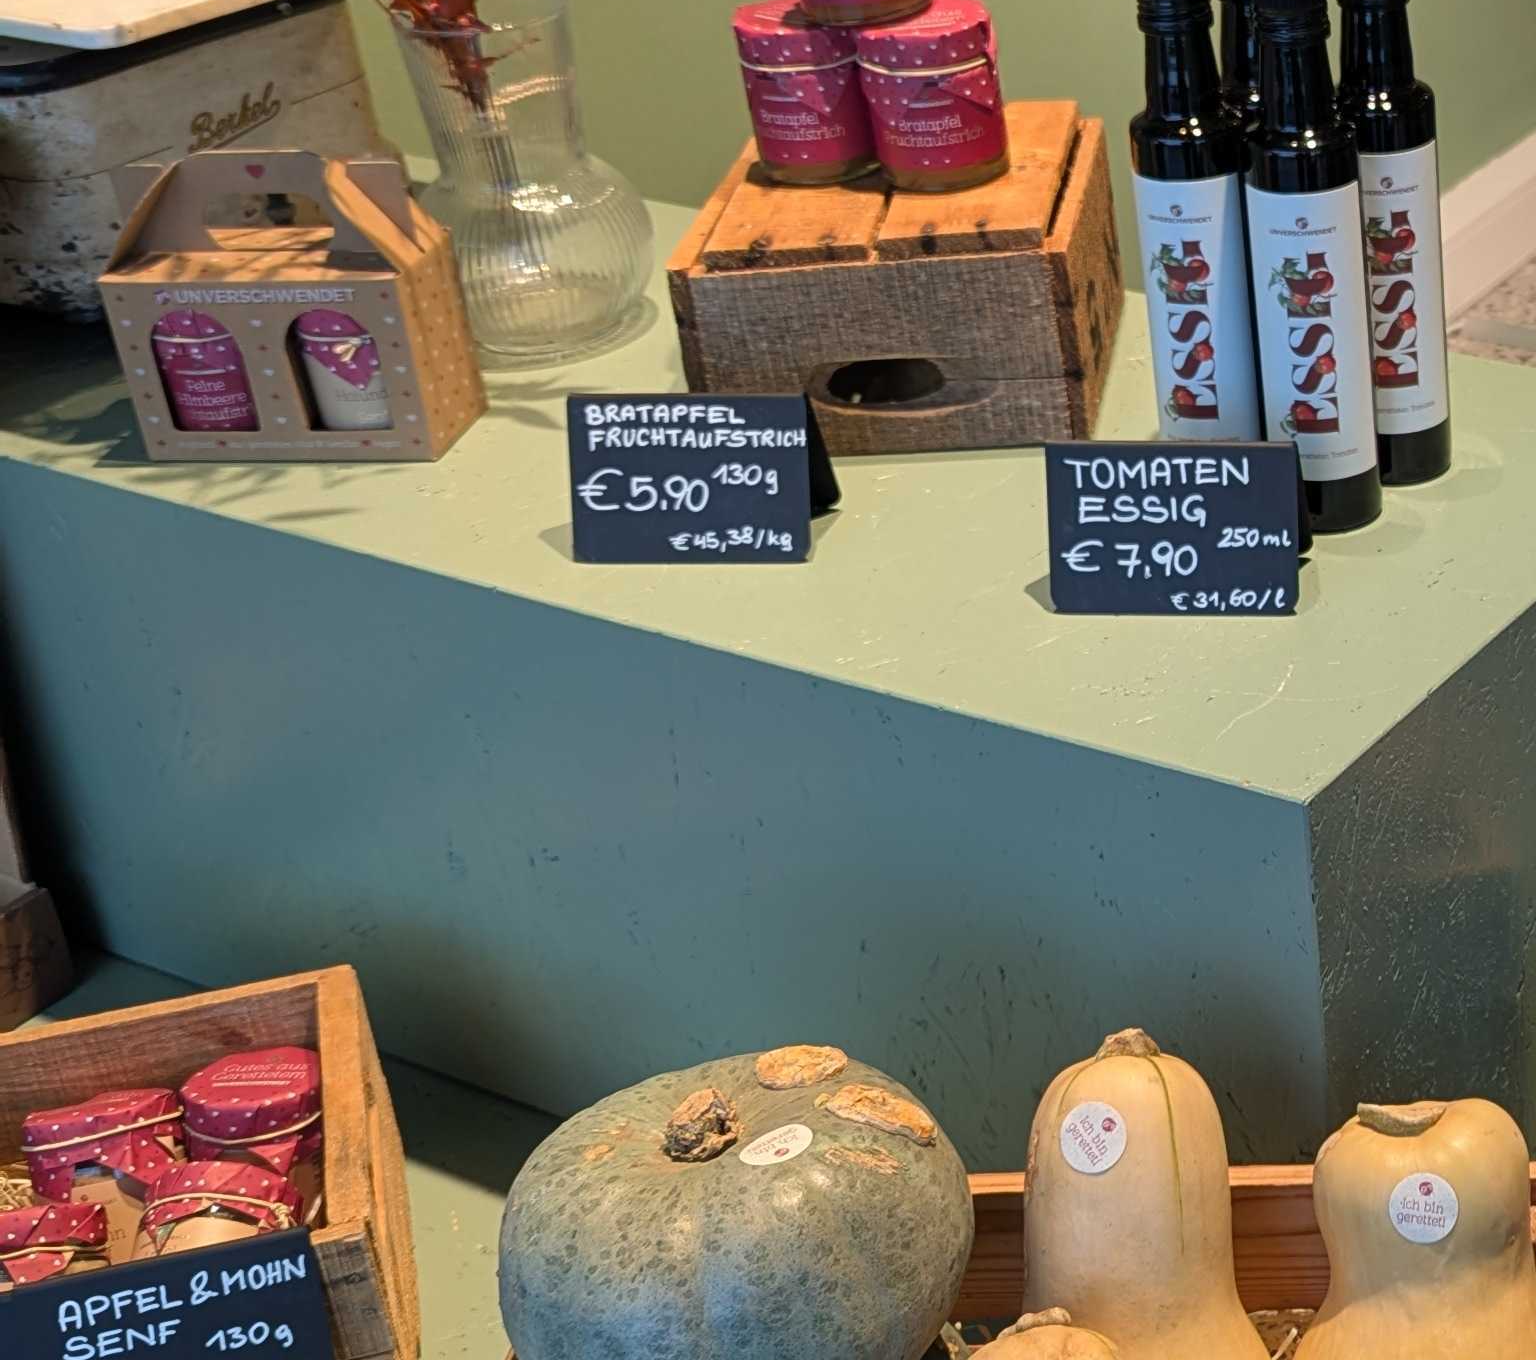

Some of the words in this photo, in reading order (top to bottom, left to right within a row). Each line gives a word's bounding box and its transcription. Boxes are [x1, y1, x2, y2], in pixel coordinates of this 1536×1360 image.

[175, 287, 356, 304] UNVERSCHWENDET
[584, 404, 746, 425] BRATAPFEL
[588, 427, 808, 452] FRUCHTAUFSTRICH
[1063, 457, 1250, 490] TOMATEN
[1078, 495, 1206, 527] ESSIG
[1401, 1197, 1421, 1212] ich
[1423, 1200, 1444, 1215] bin
[57, 1285, 184, 1332] APFEL
[189, 1270, 218, 1306] &
[220, 1254, 307, 1296] MOHN
